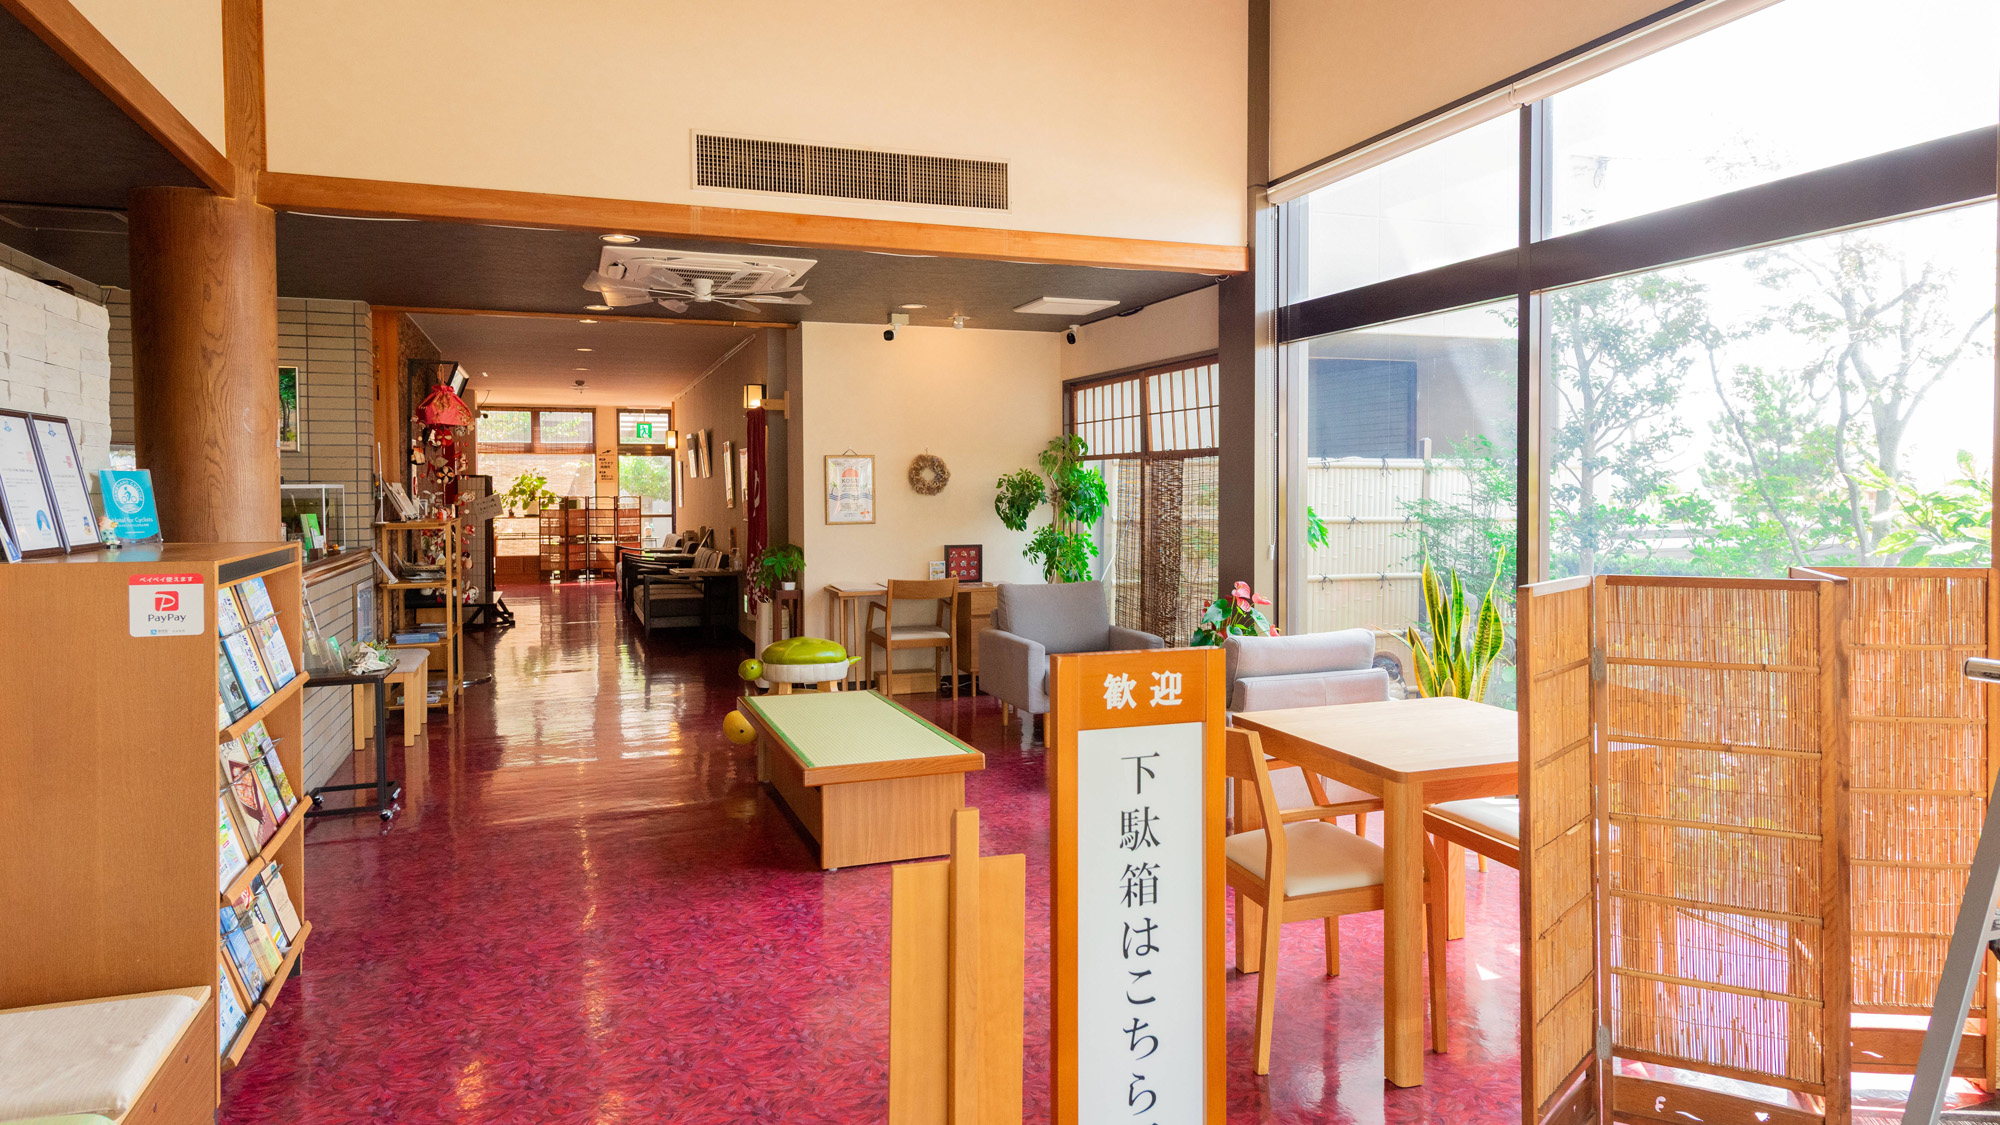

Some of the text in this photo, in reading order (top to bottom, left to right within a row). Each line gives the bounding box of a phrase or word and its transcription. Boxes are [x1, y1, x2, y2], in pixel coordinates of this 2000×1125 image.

[148, 613, 186, 623] PayPay
[1103, 670, 1183, 710] 歓迎
[1119, 752, 1161, 1125] 下駄箱はこちら
